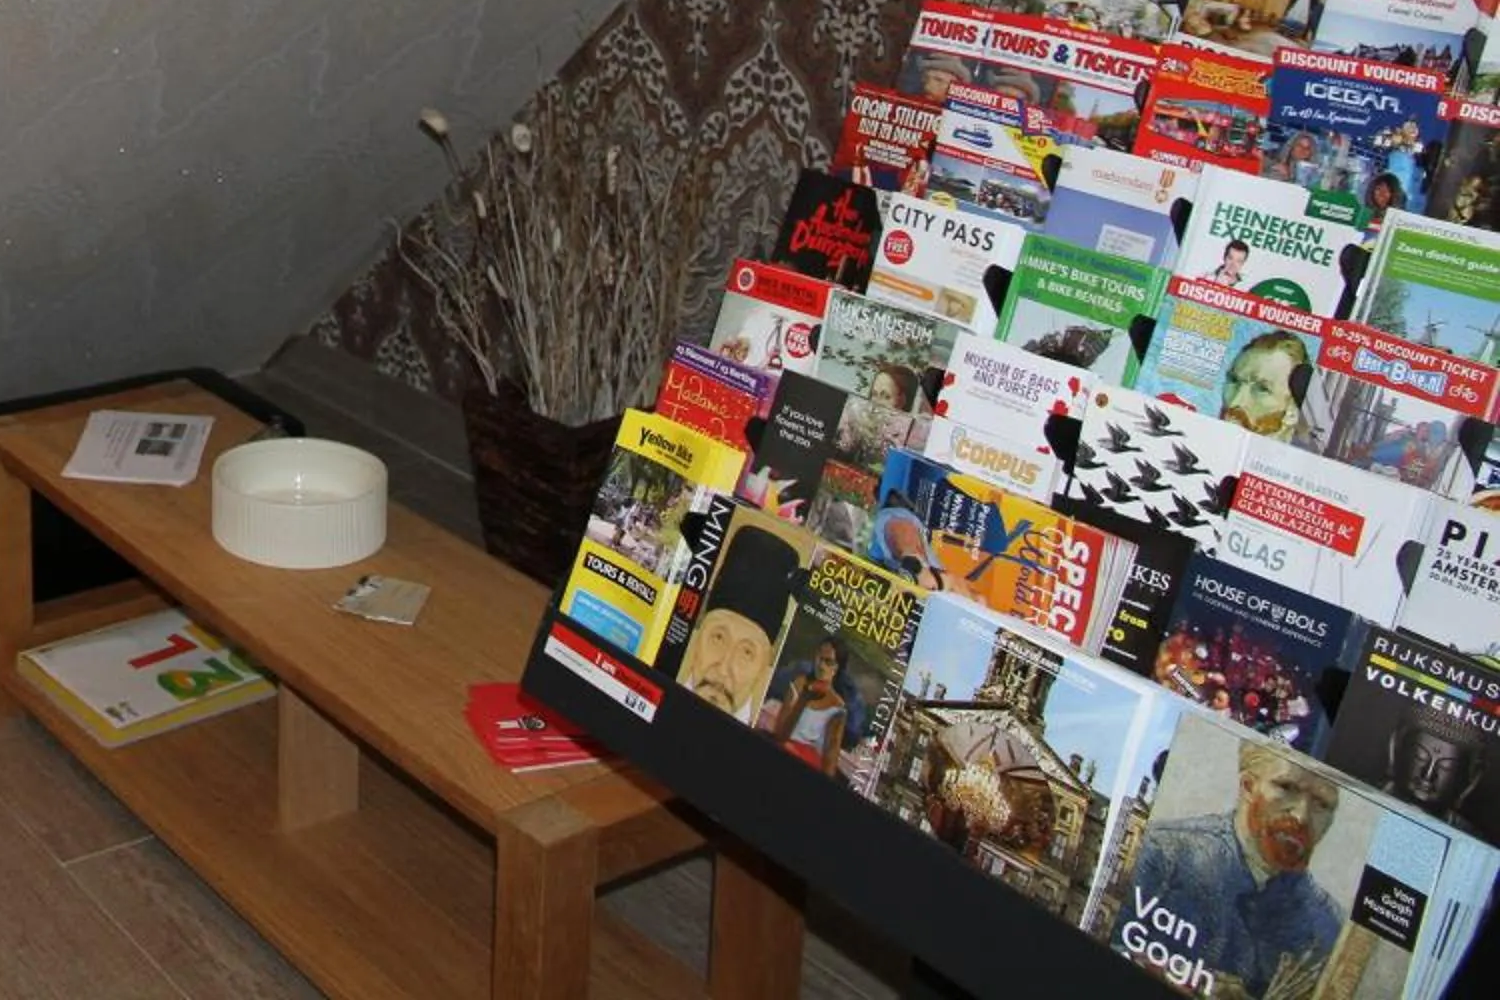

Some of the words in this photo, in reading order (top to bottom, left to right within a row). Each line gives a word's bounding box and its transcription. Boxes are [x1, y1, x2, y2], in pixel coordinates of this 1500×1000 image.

[919, 16, 978, 45] TOURS
[991, 27, 1051, 58] TOURS
[1053, 43, 1071, 63] &
[1280, 50, 1359, 76] DISCOUNT
[1363, 61, 1438, 90] VOUCHER
[891, 203, 936, 232] CITY
[942, 219, 996, 252] PASS
[1209, 220, 1335, 268] EXPERIENCE
[1214, 201, 1325, 246] HEINEKEN
[1100, 275, 1146, 302] TOURS
[1178, 280, 1256, 316] DISCOUNT
[1257, 299, 1324, 334] VOUCHER
[963, 350, 1010, 382] MUSEUM
[1011, 365, 1027, 381] OF
[1028, 372, 1061, 394] BAGS
[1373, 334, 1438, 368] DISCOUNT
[1439, 357, 1489, 383] TICKET
[972, 369, 997, 388] AND
[998, 376, 1041, 403] PURSES
[789, 409, 805, 422] you
[954, 437, 1043, 486] CORPUS
[1239, 487, 1336, 531] GLASMUSEUM
[1243, 474, 1326, 516] NATIONAAL
[687, 499, 732, 590] MING
[1227, 529, 1288, 573] GLAS
[1440, 518, 1500, 567] PI
[821, 557, 915, 614] GAUGUIN
[1431, 559, 1500, 594] AMSTER
[1456, 553, 1497, 577] YEARS
[808, 570, 906, 631] BONNARD
[1193, 573, 1245, 607] HOUSE
[1246, 593, 1269, 614] OF
[1285, 608, 1329, 638] BOLS
[842, 609, 902, 651] DENIS
[1374, 636, 1500, 699] RIJKSMUS
[1366, 665, 1500, 738] VOLKENKU
[1135, 886, 1197, 948] Van
[1363, 897, 1411, 929] Museum
[1382, 894, 1414, 919] Gogh
[1392, 887, 1416, 907] Van
[1121, 921, 1214, 997] Gogh
